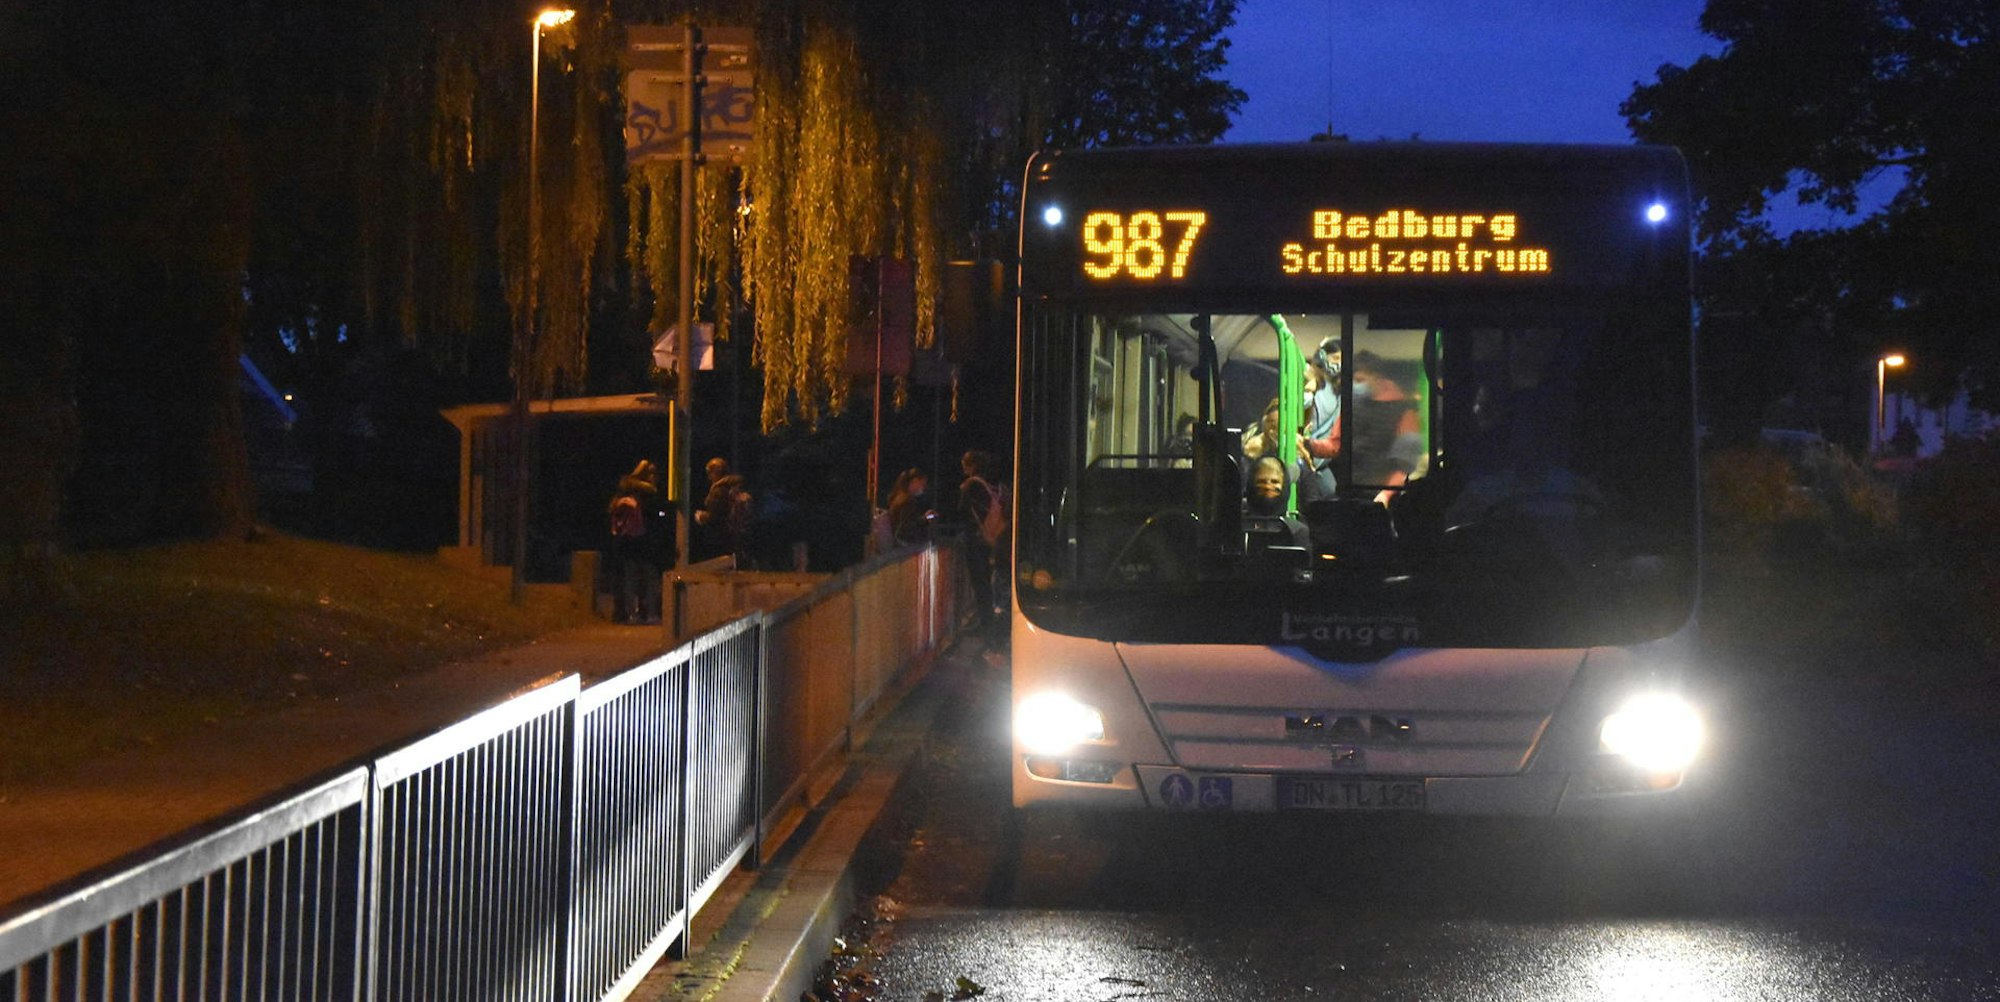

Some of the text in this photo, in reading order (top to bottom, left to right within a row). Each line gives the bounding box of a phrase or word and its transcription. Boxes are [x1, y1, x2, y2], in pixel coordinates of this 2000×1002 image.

[1313, 210, 1516, 242] Bedburg
[1084, 211, 1206, 279] 987
[1282, 242, 1549, 274] Schulzentrum
[1281, 611, 1420, 646] Langen
[1286, 713, 1415, 742] MAN
